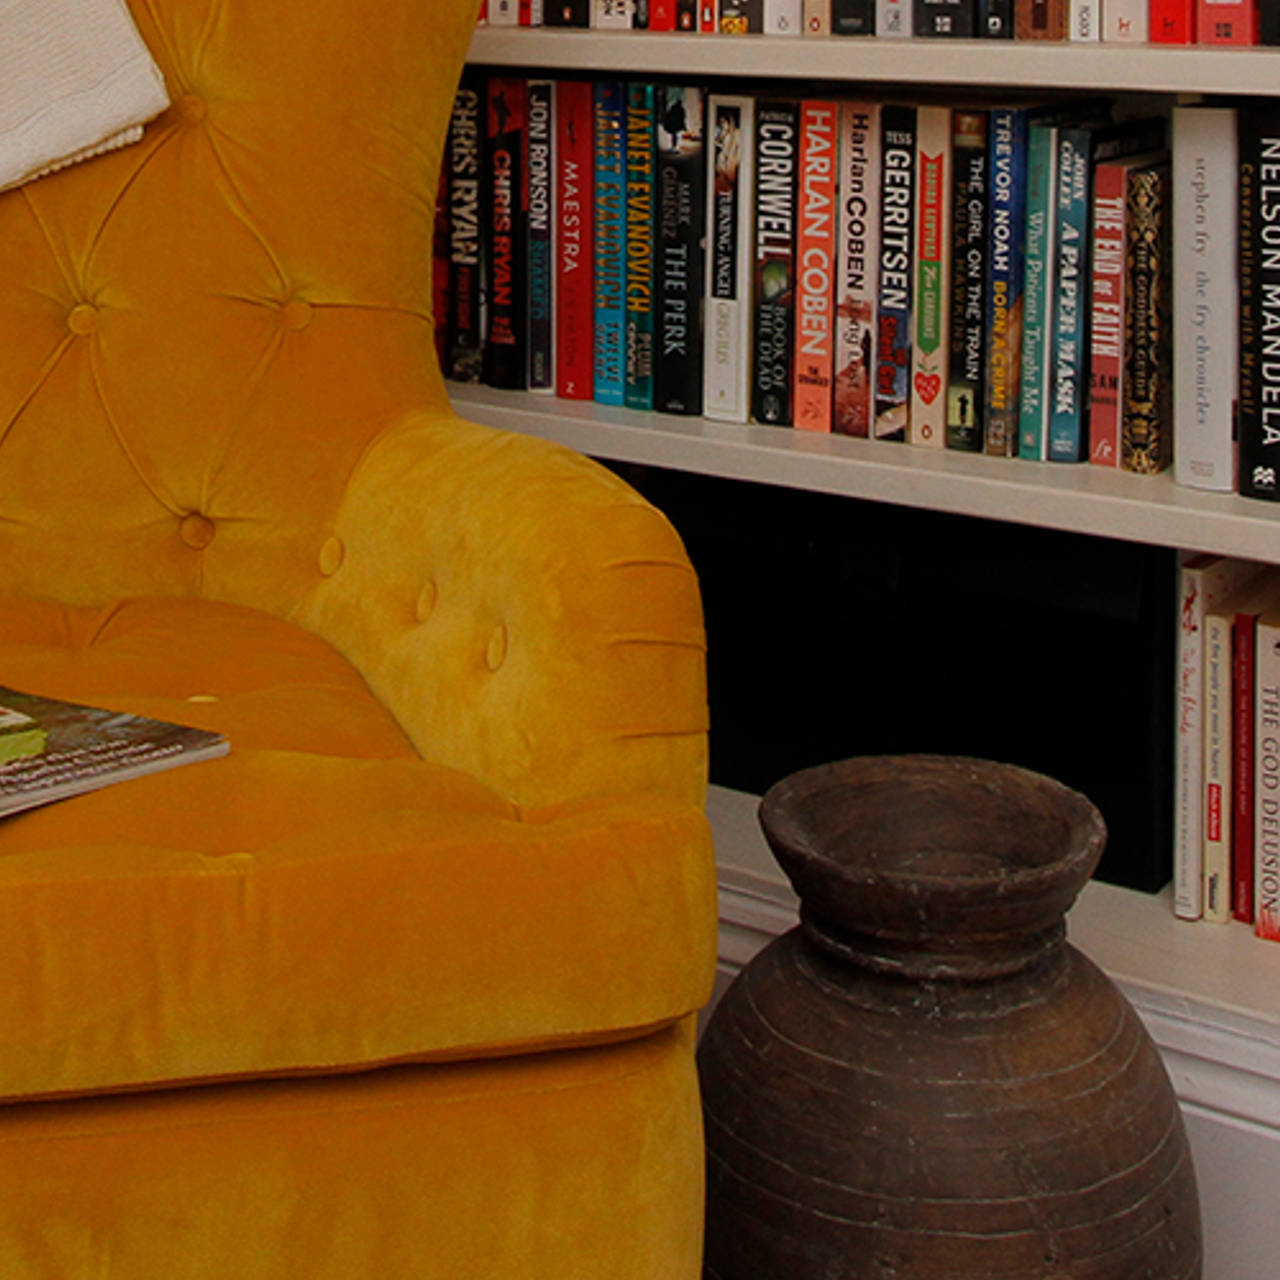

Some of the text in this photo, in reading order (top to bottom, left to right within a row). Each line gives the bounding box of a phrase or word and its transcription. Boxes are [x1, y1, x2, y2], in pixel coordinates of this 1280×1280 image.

[451, 179, 478, 266] RYAN
[492, 149, 511, 232] CHRIS
[529, 96, 549, 230] JON RONSON
[563, 160, 581, 272] MAESTRA
[593, 103, 622, 311] JANET EVANOVICH
[625, 105, 651, 312] JANET EVANOVICH
[757, 123, 794, 260] CORNWELL
[803, 109, 832, 238] HARLAN
[846, 113, 869, 291] Harlan COBEN
[993, 115, 1012, 271] TREVOR NOAH
[1096, 196, 1123, 231] THE
[492, 235, 511, 306] RYAN
[879, 148, 912, 310] GERRITSEN
[965, 158, 984, 381] THE GIRL ON THE TRAIN
[1093, 238, 1122, 273] END
[1193, 231, 1212, 258] fry
[1195, 271, 1213, 298] the
[664, 243, 687, 356] THE PERK
[800, 247, 830, 357] COBEN
[1021, 210, 1044, 415] What Patients Taught Me
[1056, 221, 1079, 414] A PAPER MASK
[1091, 301, 1121, 358] FAITH
[1194, 335, 1211, 426] chronicles
[1261, 686, 1280, 912] THE GOD DELUSION
